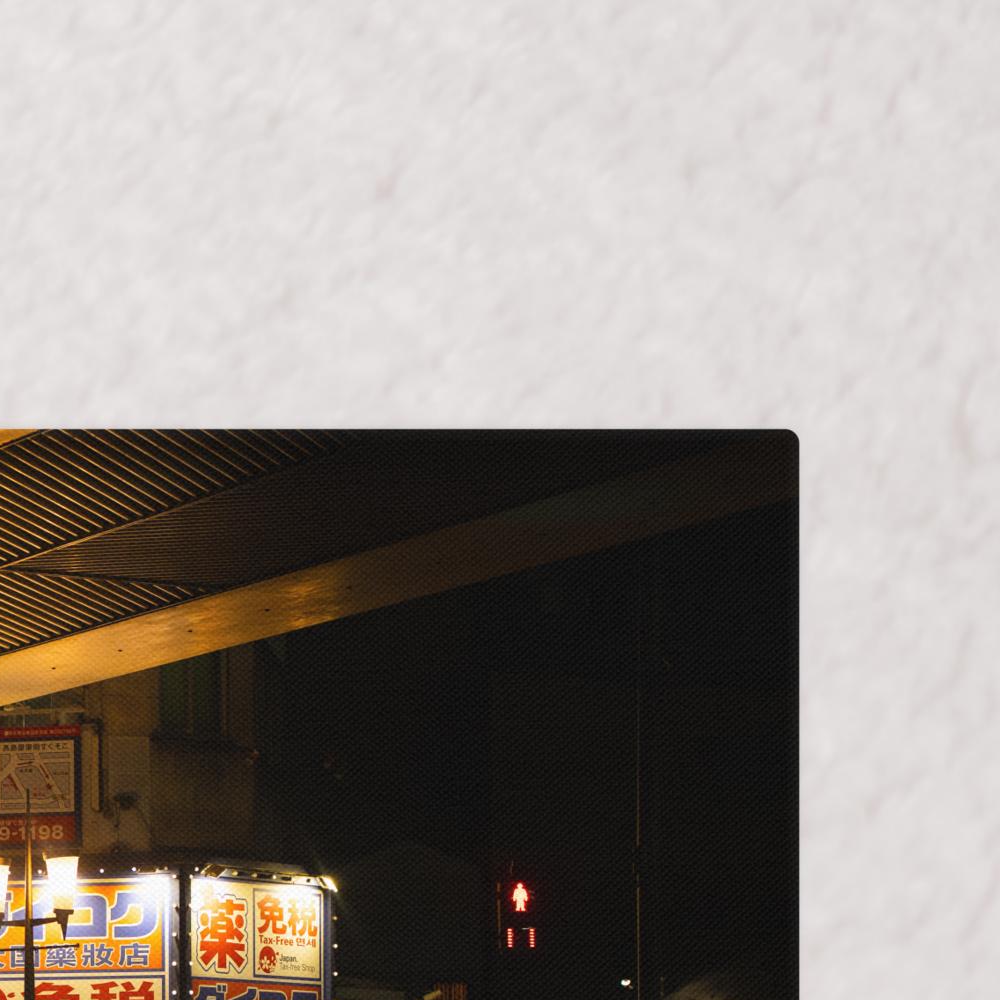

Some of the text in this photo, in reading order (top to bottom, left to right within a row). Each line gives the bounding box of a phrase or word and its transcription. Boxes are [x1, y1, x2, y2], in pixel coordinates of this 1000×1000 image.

[199, 897, 246, 969] 薬
[257, 895, 318, 937] 免税
[259, 935, 294, 946] Tax-Free
